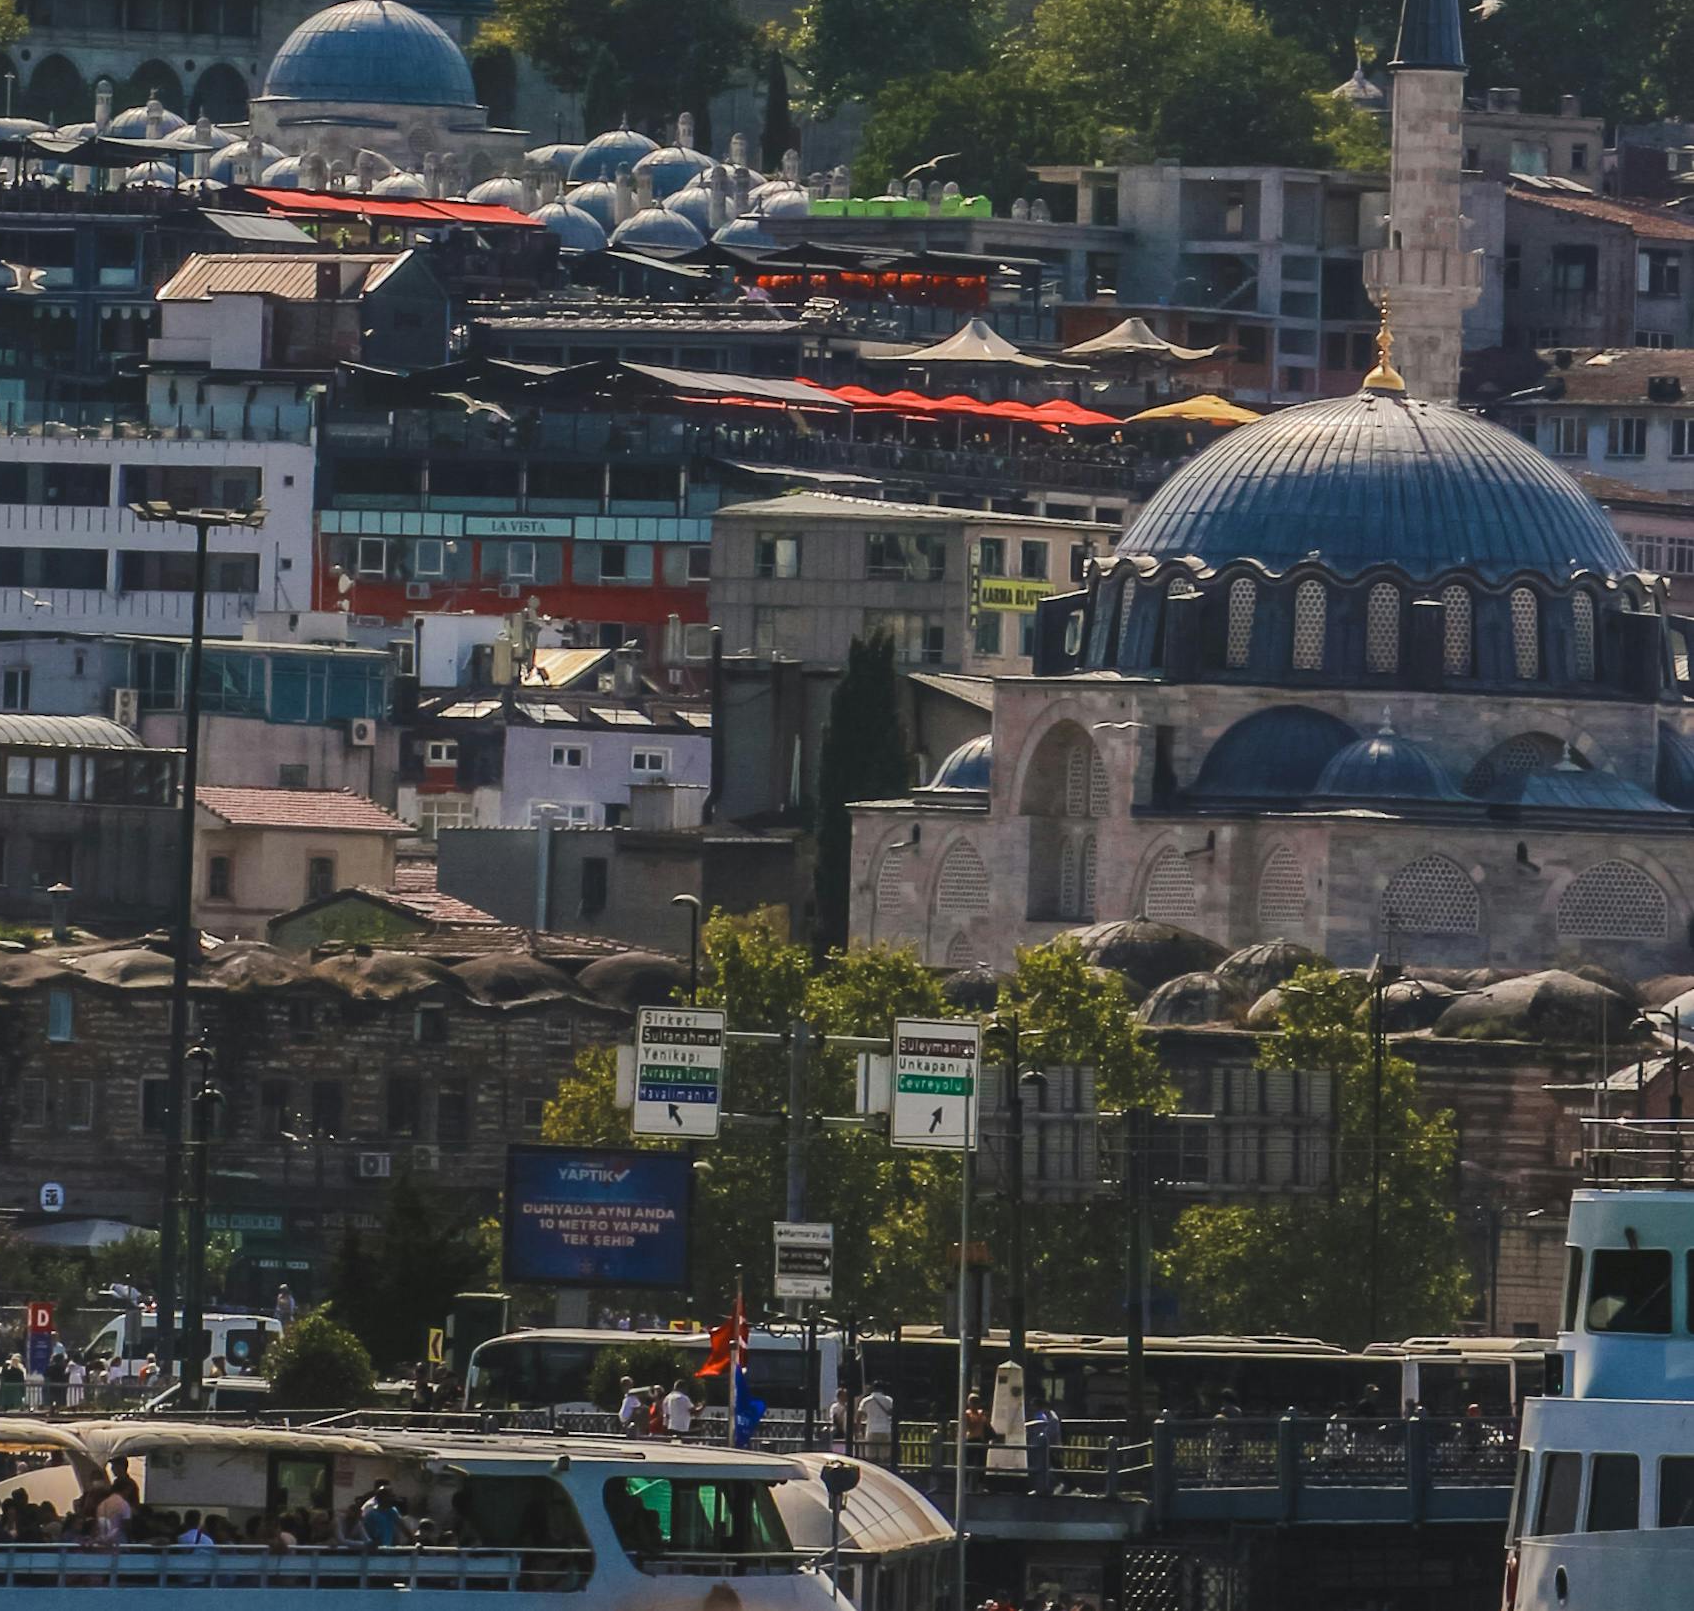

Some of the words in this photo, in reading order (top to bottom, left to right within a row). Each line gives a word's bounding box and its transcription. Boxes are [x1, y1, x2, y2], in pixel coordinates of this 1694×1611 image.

[491, 520, 508, 533] LA
[510, 520, 546, 533] VISTA
[645, 1011, 698, 1026] Sirkeci
[644, 1028, 720, 1045] Sultanahmet
[641, 1065, 682, 1081] Avrasya
[558, 1168, 615, 1182] YAPTIK
[597, 1206, 631, 1218] AYNI
[634, 1208, 675, 1220] ANDA
[539, 1218, 554, 1229] 10
[558, 1219, 609, 1232] METRO
[612, 1222, 659, 1234] YAPAN
[562, 1233, 588, 1245] TEK
[37, 1314, 49, 1326] D
